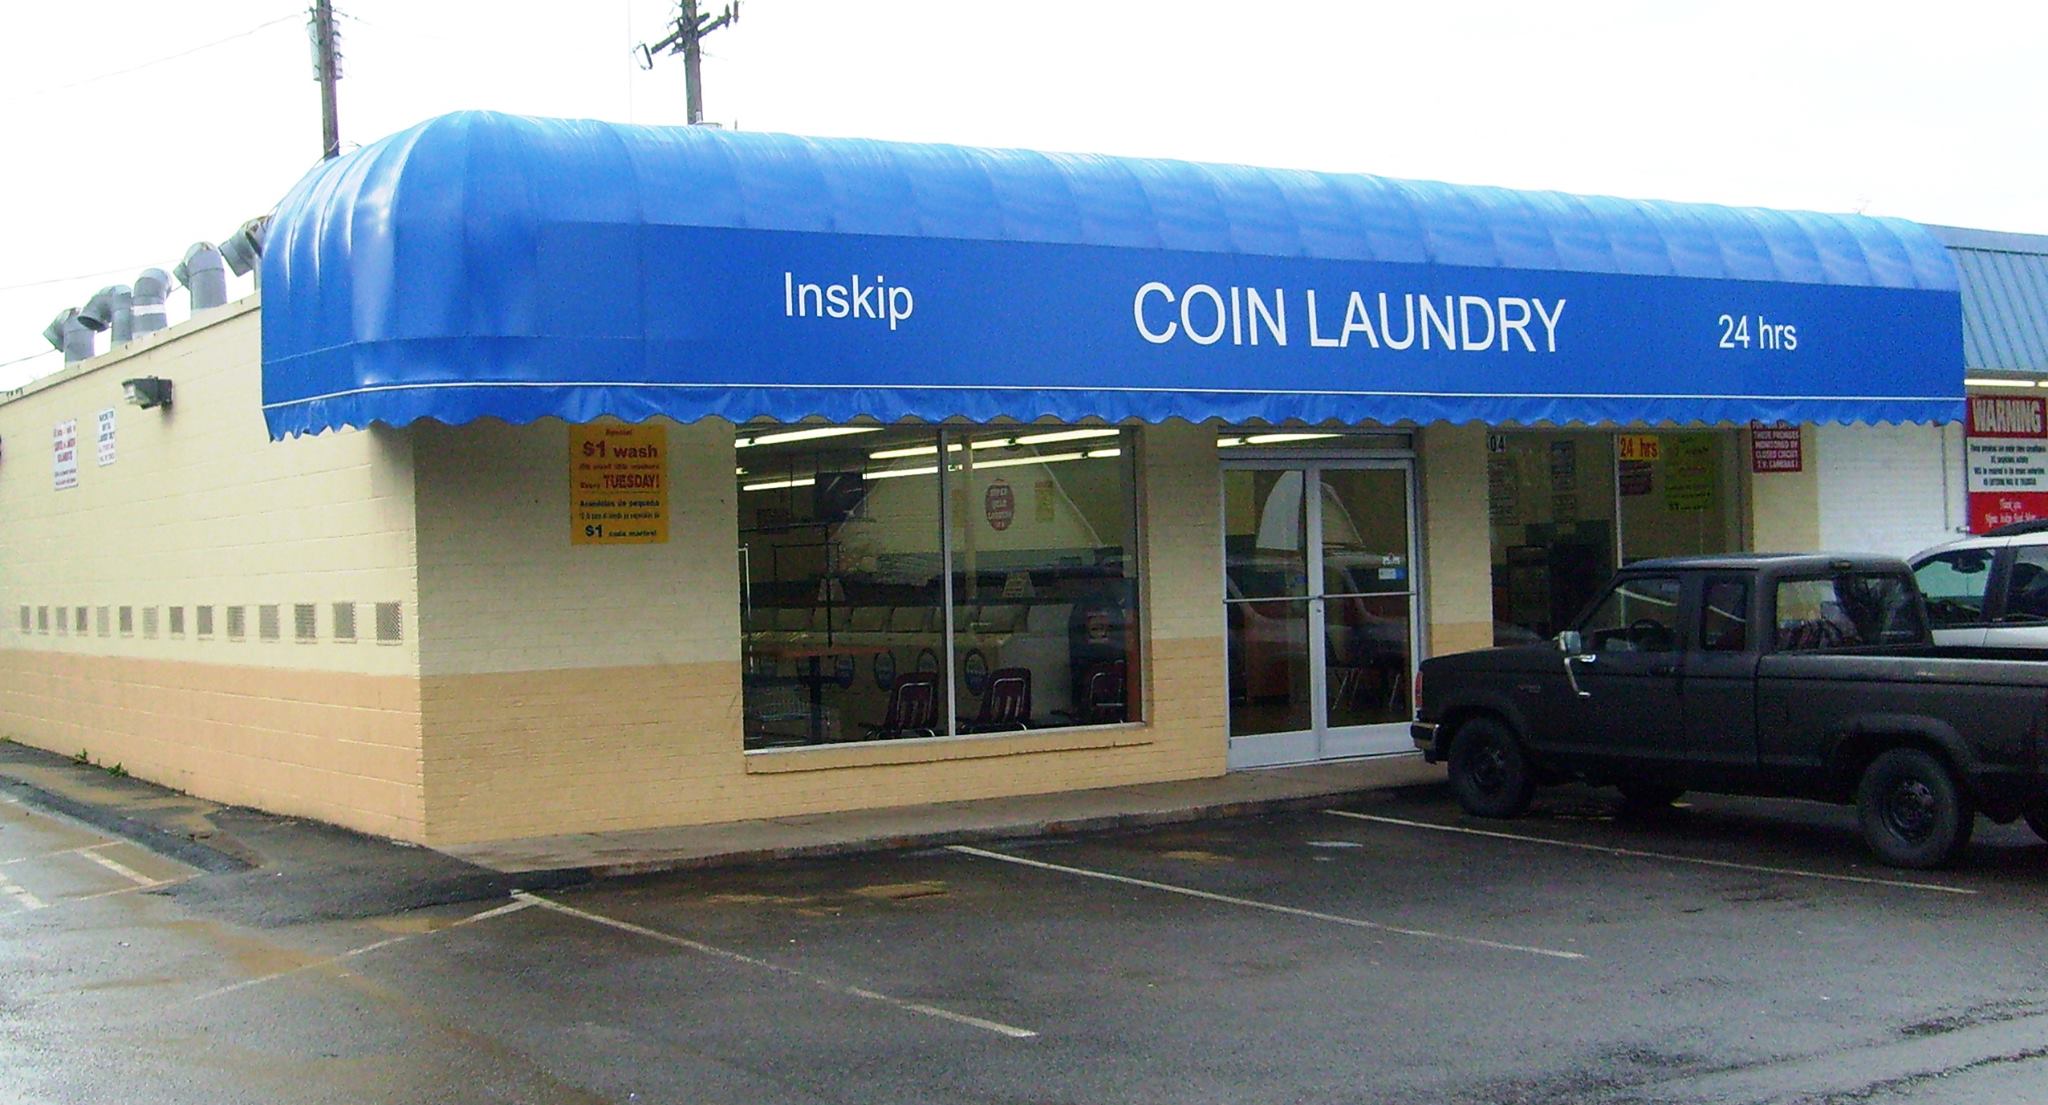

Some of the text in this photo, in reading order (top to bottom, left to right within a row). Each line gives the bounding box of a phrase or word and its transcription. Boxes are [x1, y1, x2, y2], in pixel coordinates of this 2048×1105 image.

[785, 272, 914, 331] Inskip
[1133, 281, 1566, 353] COIN LAUNDRY
[1718, 314, 1797, 351] 24 hrs
[1972, 399, 2041, 433] WARNING
[583, 441, 658, 458] $1 wash
[1620, 437, 1658, 458] 24 hrs
[603, 473, 660, 489] TUESDAY!
[585, 525, 603, 538] $1
